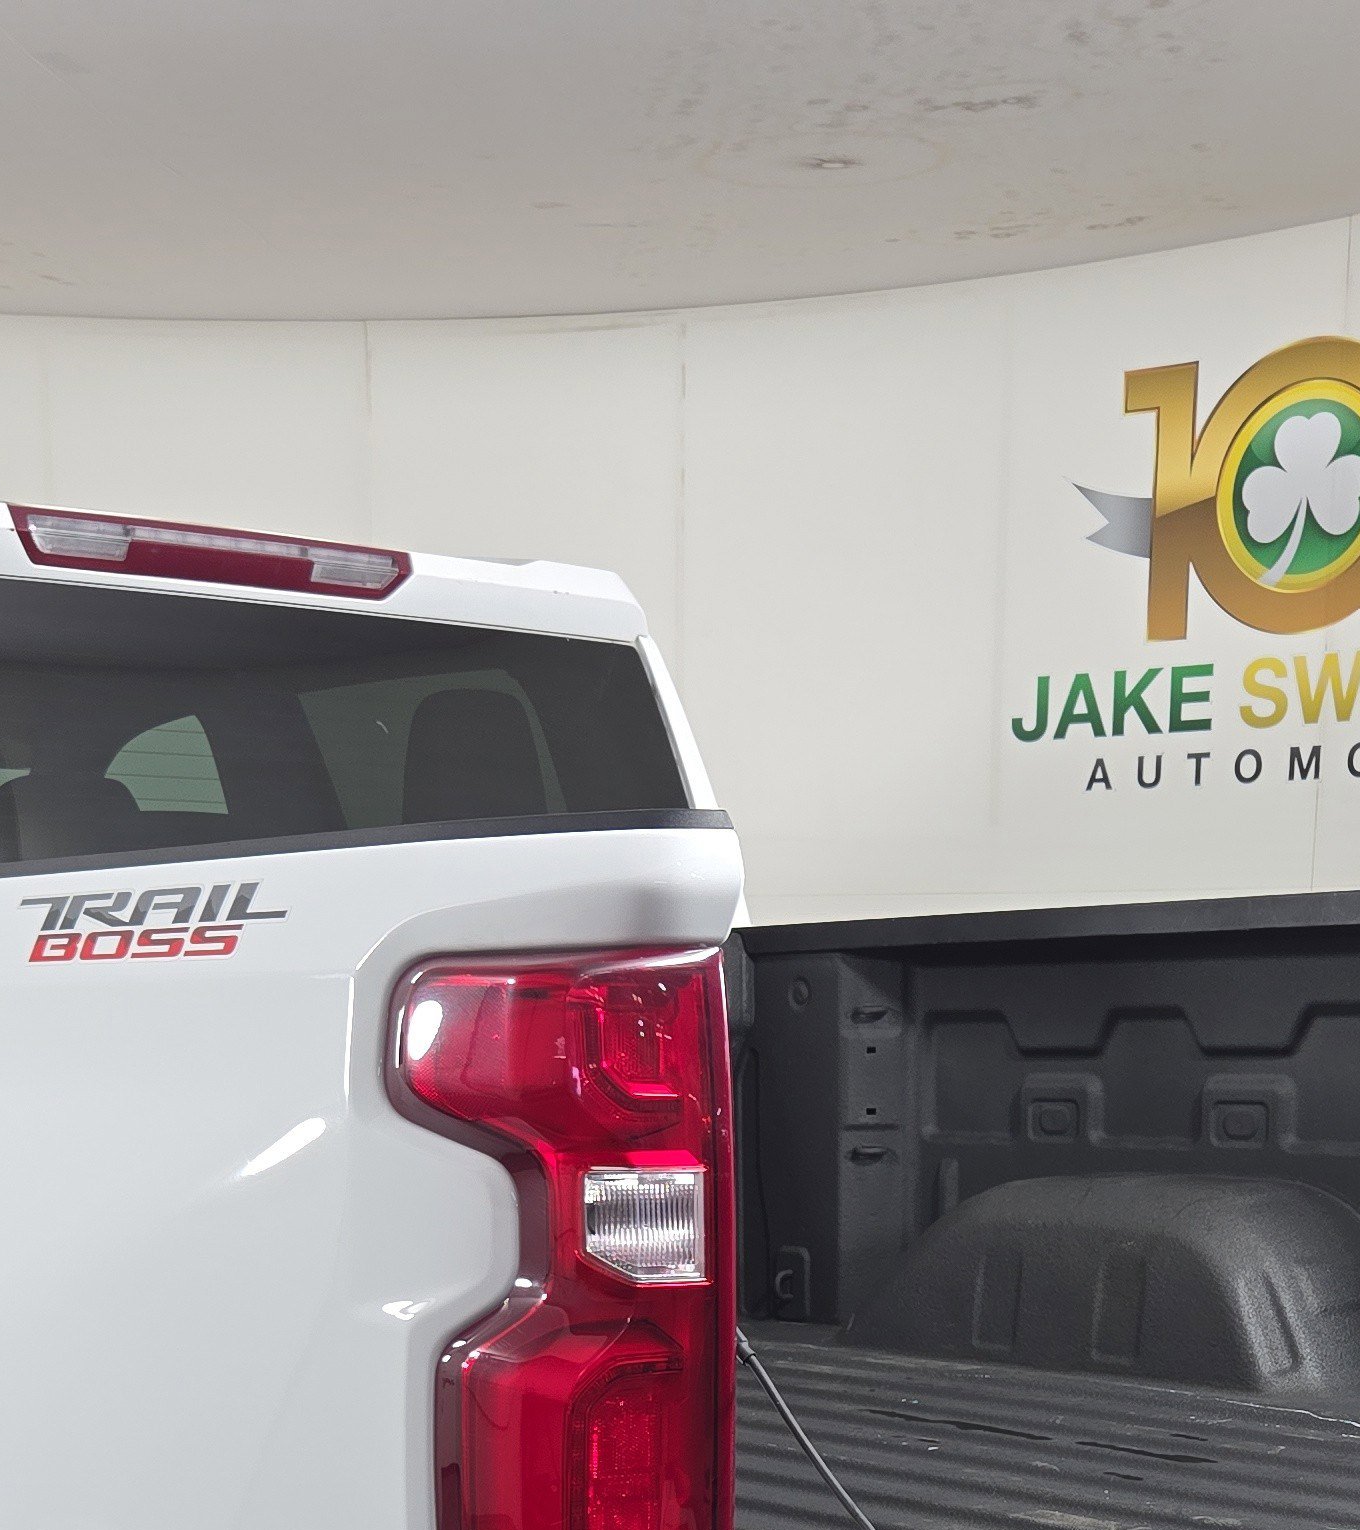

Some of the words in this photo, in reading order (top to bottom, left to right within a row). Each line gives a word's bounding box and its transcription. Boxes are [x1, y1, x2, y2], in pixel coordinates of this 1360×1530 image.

[1011, 663, 1214, 744] JAKE
[20, 881, 288, 931] TRAIL
[28, 923, 245, 963] BOSS
